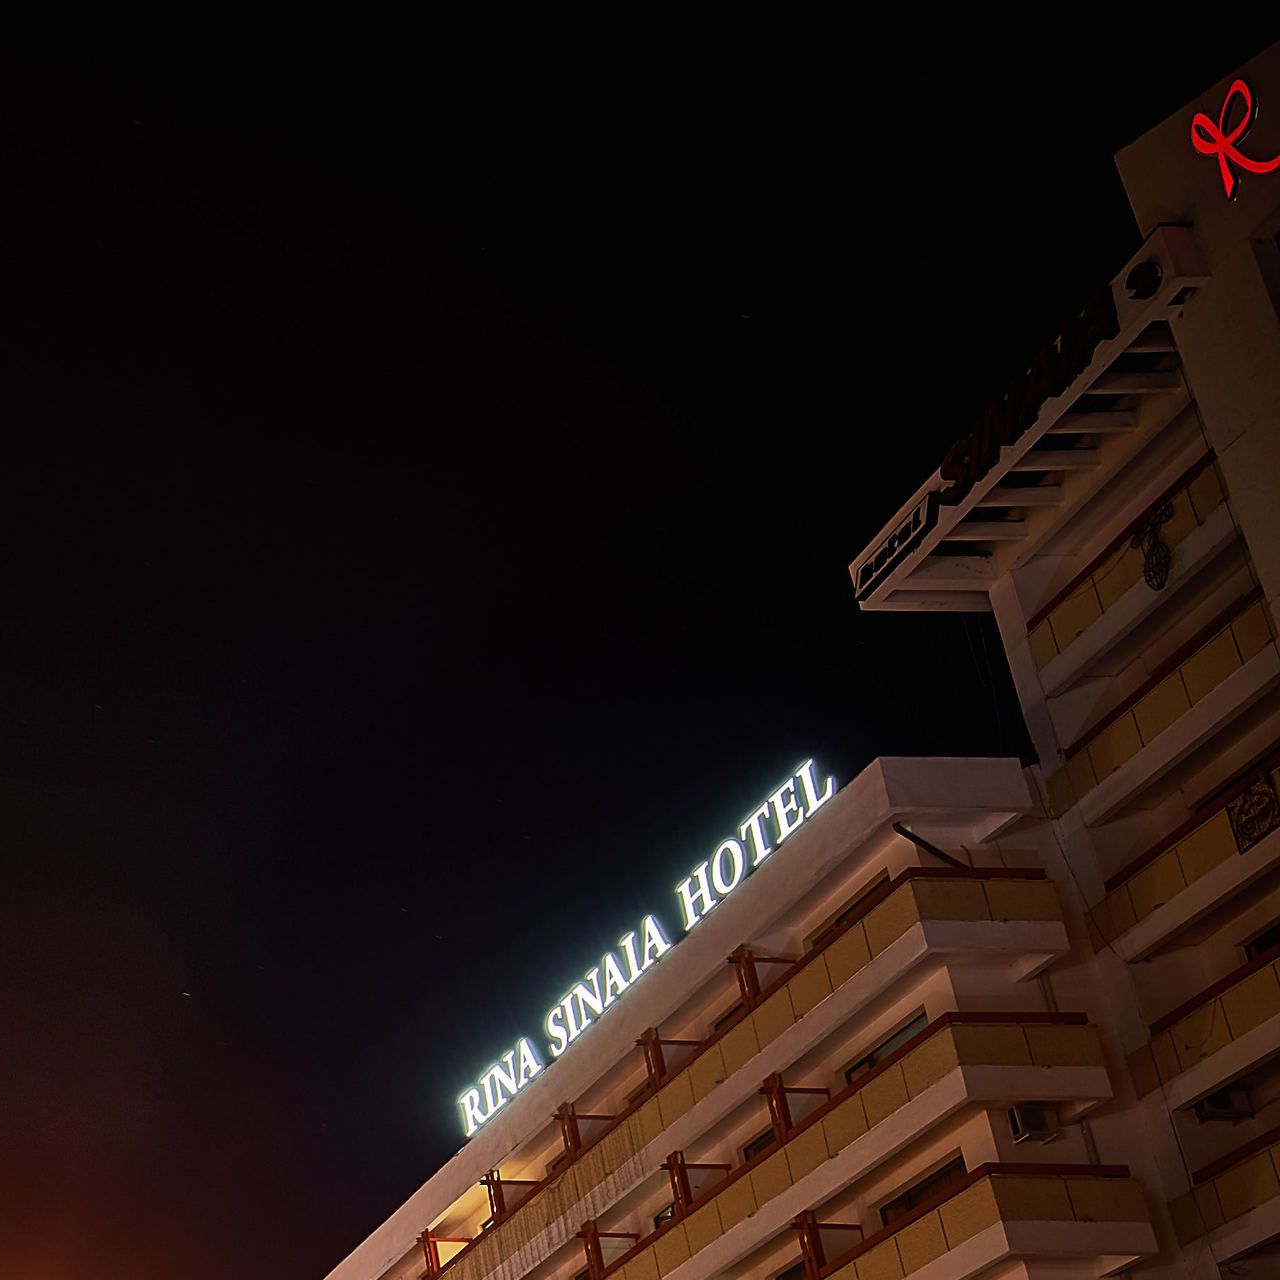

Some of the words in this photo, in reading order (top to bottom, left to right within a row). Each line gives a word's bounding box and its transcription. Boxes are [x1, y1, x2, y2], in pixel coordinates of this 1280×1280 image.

[458, 1037, 542, 1138] RINA
[544, 914, 671, 1058] SINAIA
[675, 758, 836, 931] HOTEL
